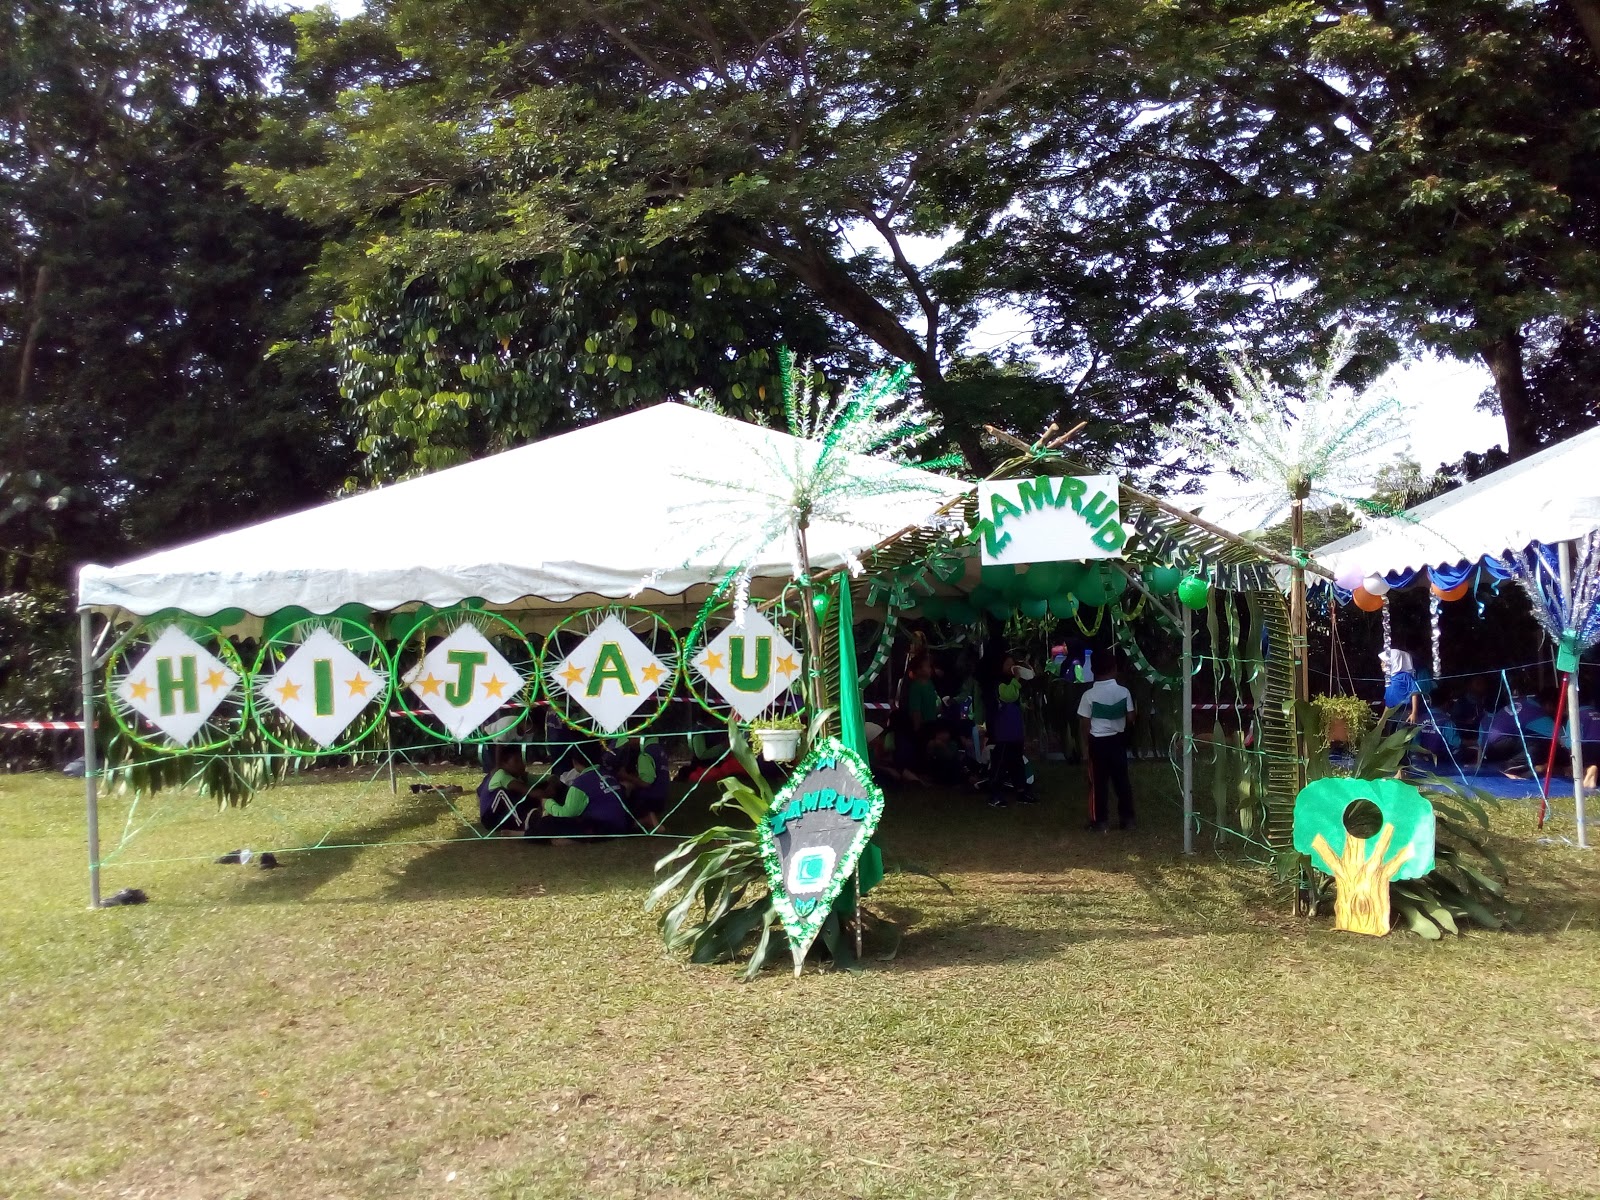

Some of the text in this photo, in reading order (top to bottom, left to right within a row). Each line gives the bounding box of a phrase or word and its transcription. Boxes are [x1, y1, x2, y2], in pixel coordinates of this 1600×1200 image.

[967, 475, 1126, 558] ZAMRUD
[1133, 510, 1273, 592] BERSINAR
[770, 788, 869, 836] ZAMRUD
